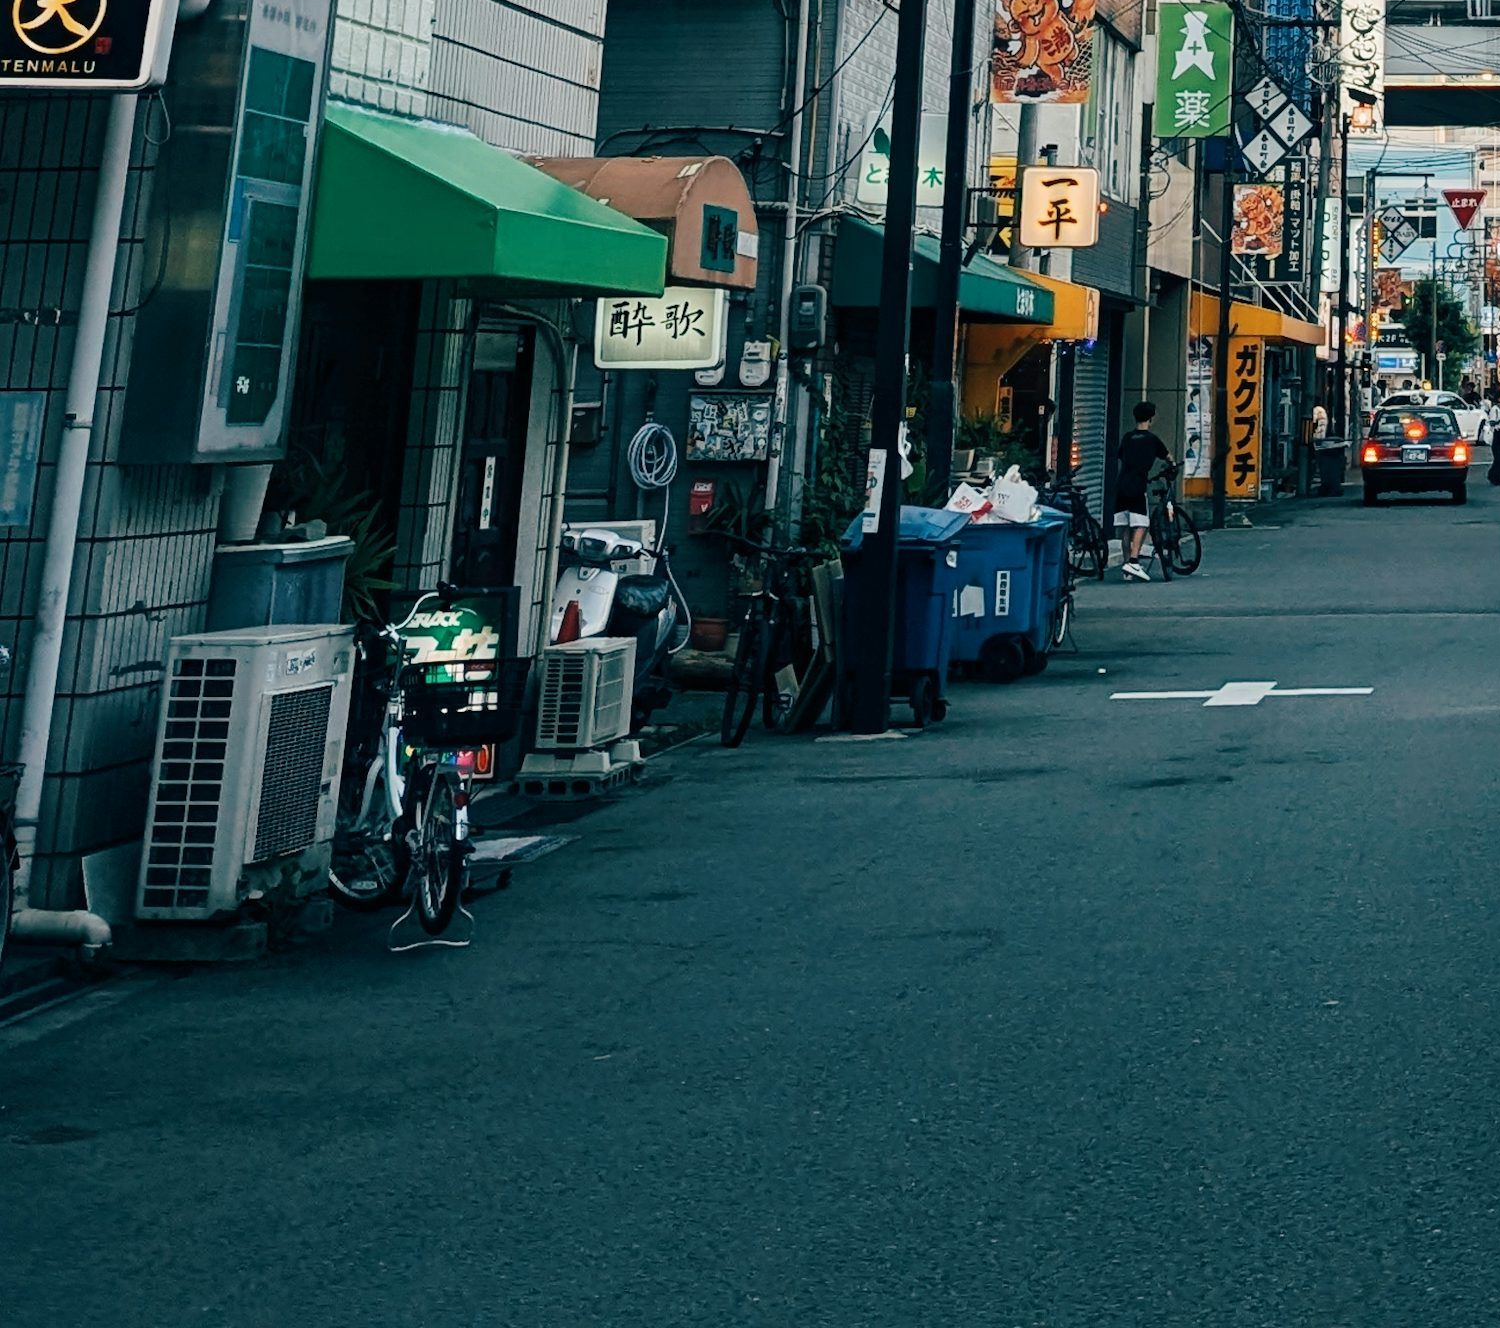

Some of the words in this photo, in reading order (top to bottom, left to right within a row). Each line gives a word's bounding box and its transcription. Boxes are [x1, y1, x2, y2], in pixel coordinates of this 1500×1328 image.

[1, 59, 97, 75] TENMALU
[1174, 91, 1211, 129] 薬
[1037, 177, 1079, 241] 一平
[1451, 197, 1479, 209] 止まれ
[610, 301, 706, 346] 酔歌
[1232, 344, 1259, 487] ガクブチ
